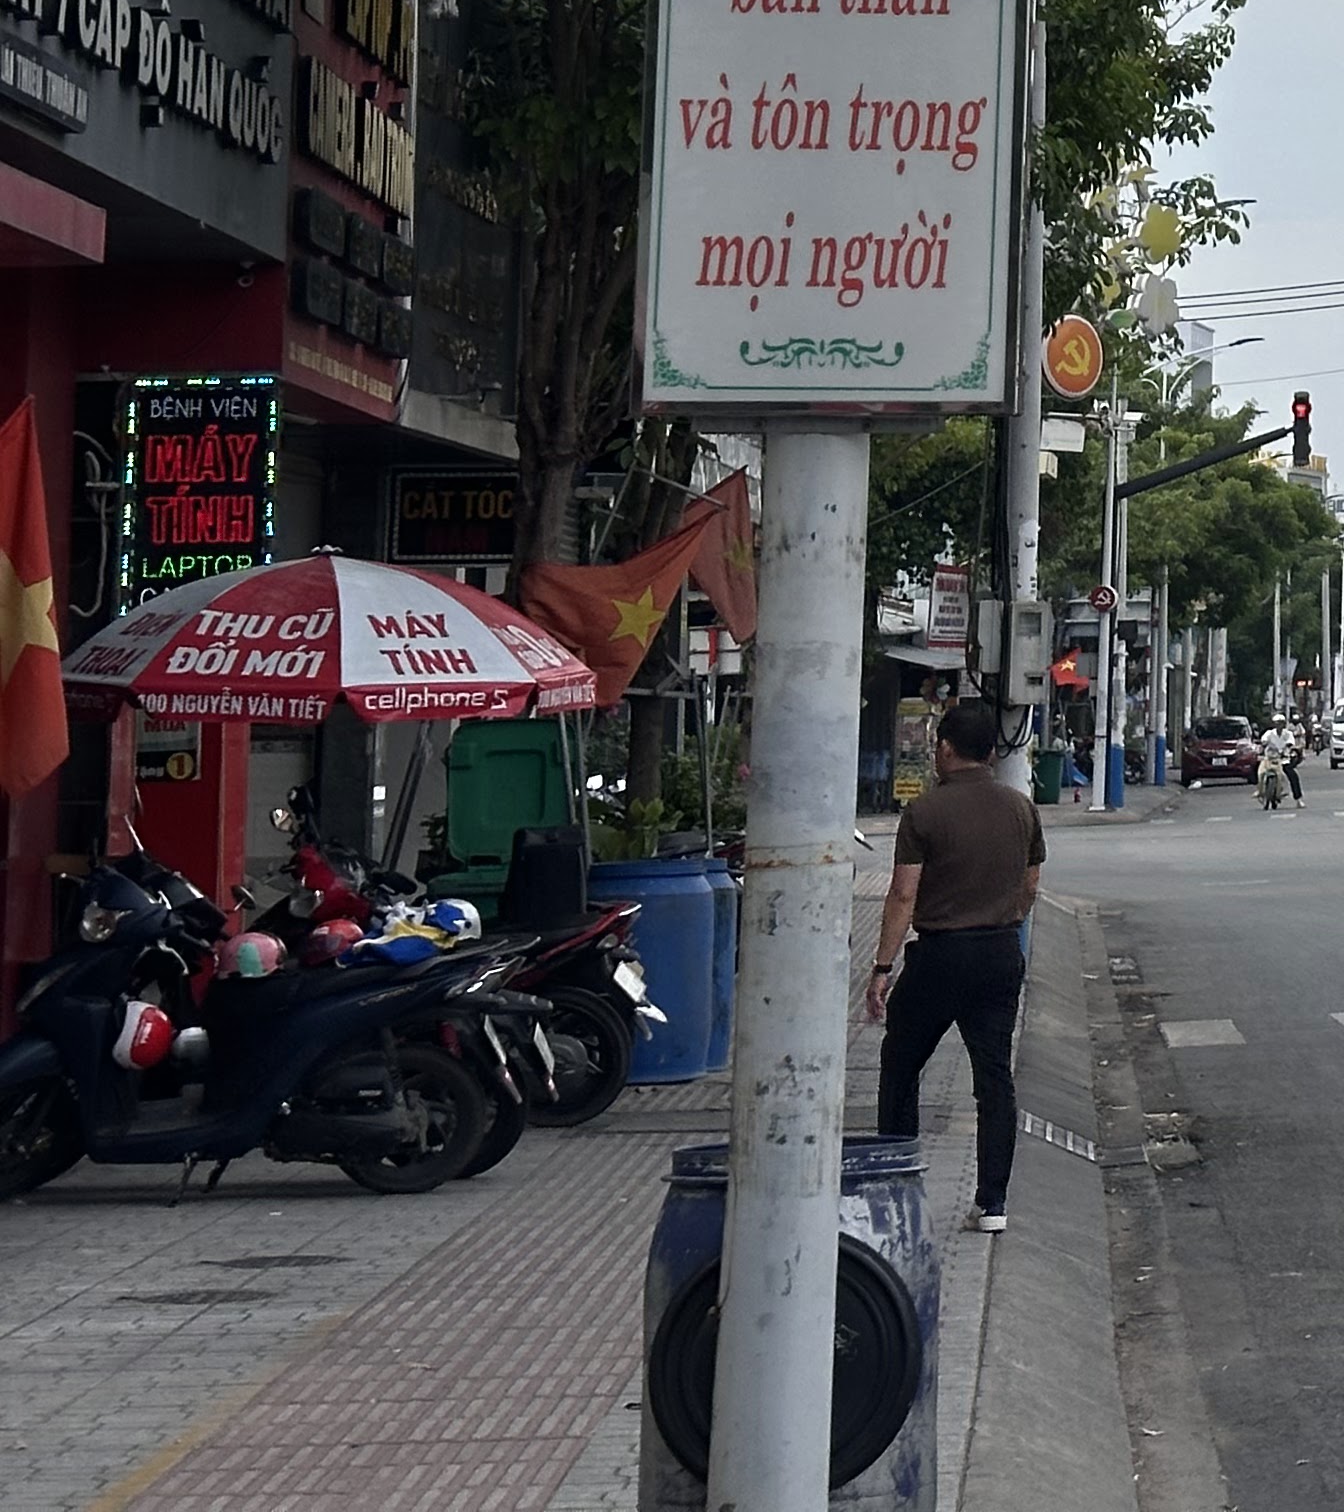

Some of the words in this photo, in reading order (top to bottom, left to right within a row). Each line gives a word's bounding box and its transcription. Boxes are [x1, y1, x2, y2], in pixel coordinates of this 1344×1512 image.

[177, 23, 226, 132] HÀN
[228, 58, 283, 164] QUỐC
[679, 72, 732, 152] và
[751, 72, 830, 152] tôn
[848, 81, 988, 175] trọng
[696, 210, 796, 312] mọi
[805, 209, 952, 308] người
[150, 395, 202, 421] BỆNH
[210, 396, 257, 421] VIỆN
[145, 484, 256, 545] TÍNH
[142, 554, 252, 580] LAPTOP
[195, 609, 274, 639] THU
[278, 607, 335, 640] CŨ
[367, 610, 449, 638] MÁY
[165, 638, 240, 675] ĐỔI
[241, 644, 327, 678] MỚI
[379, 643, 478, 675] TÍNH
[172, 687, 243, 715] NGUYỄN
[248, 693, 283, 716] VĂN
[289, 691, 328, 720] TIẾT
